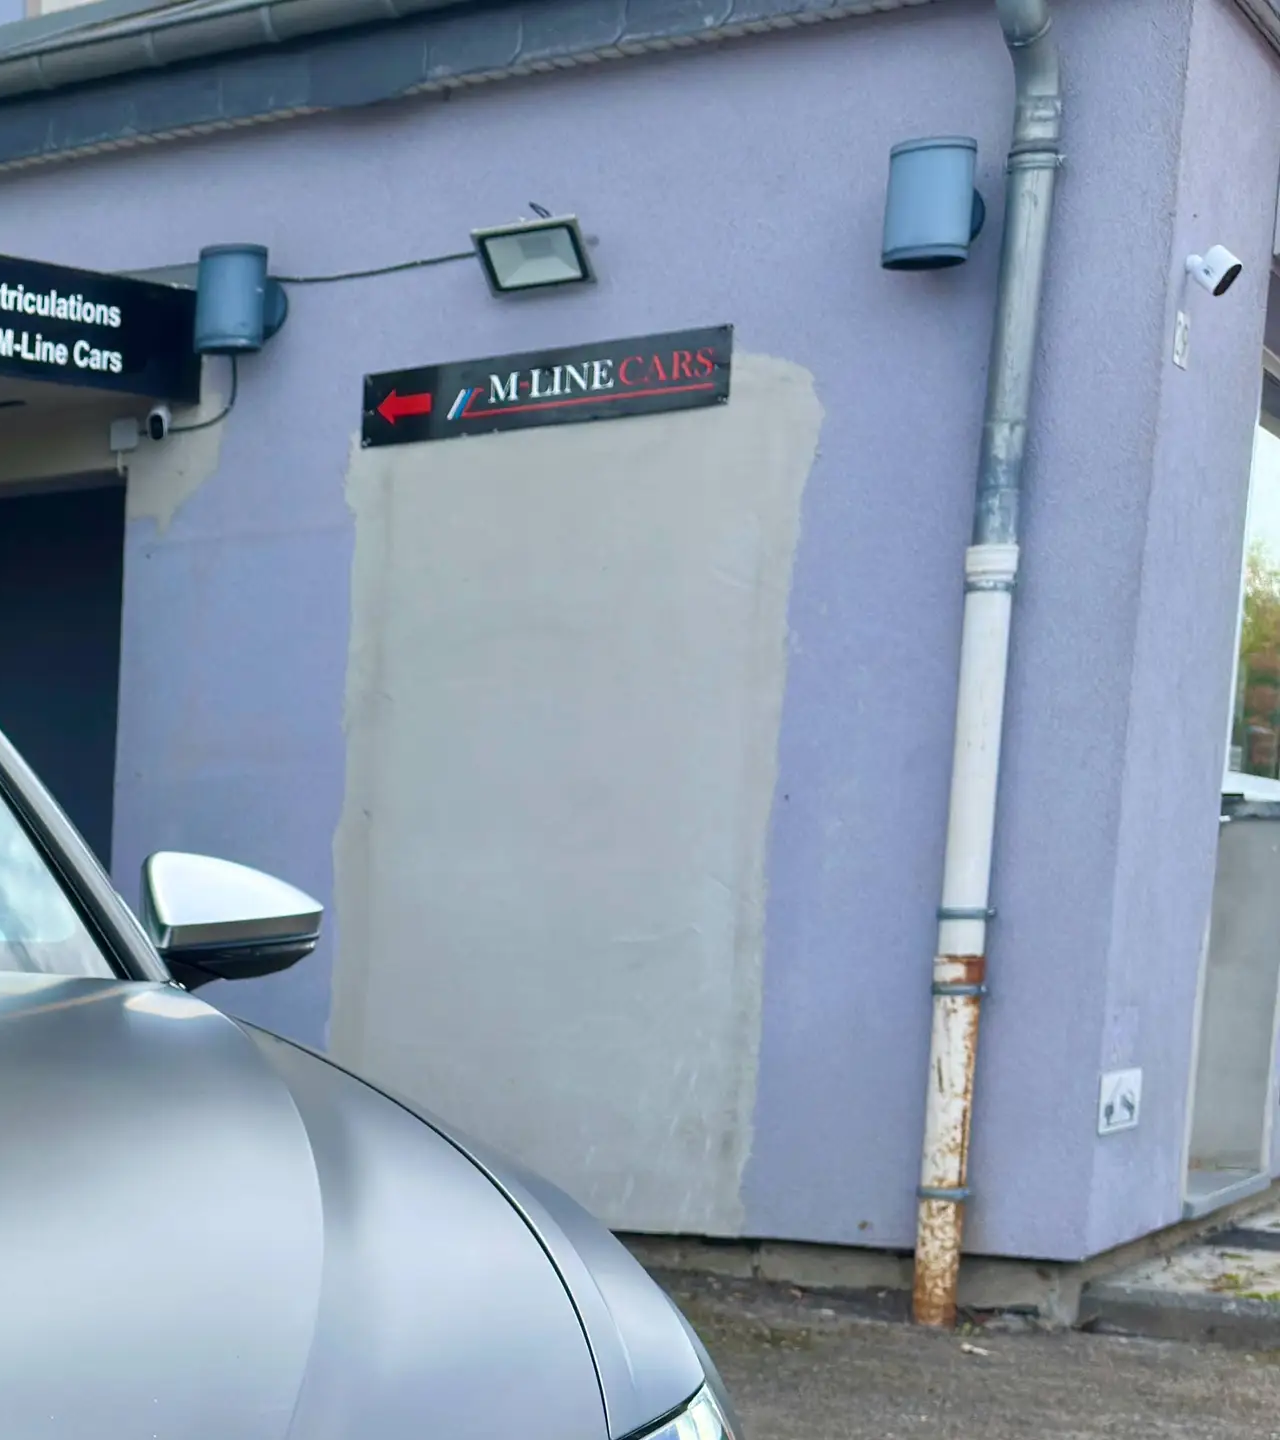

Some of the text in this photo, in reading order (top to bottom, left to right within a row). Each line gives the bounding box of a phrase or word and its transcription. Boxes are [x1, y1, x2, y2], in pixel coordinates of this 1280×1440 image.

[73, 339, 123, 374] Cars
[488, 347, 715, 404] M-LINE CARS
